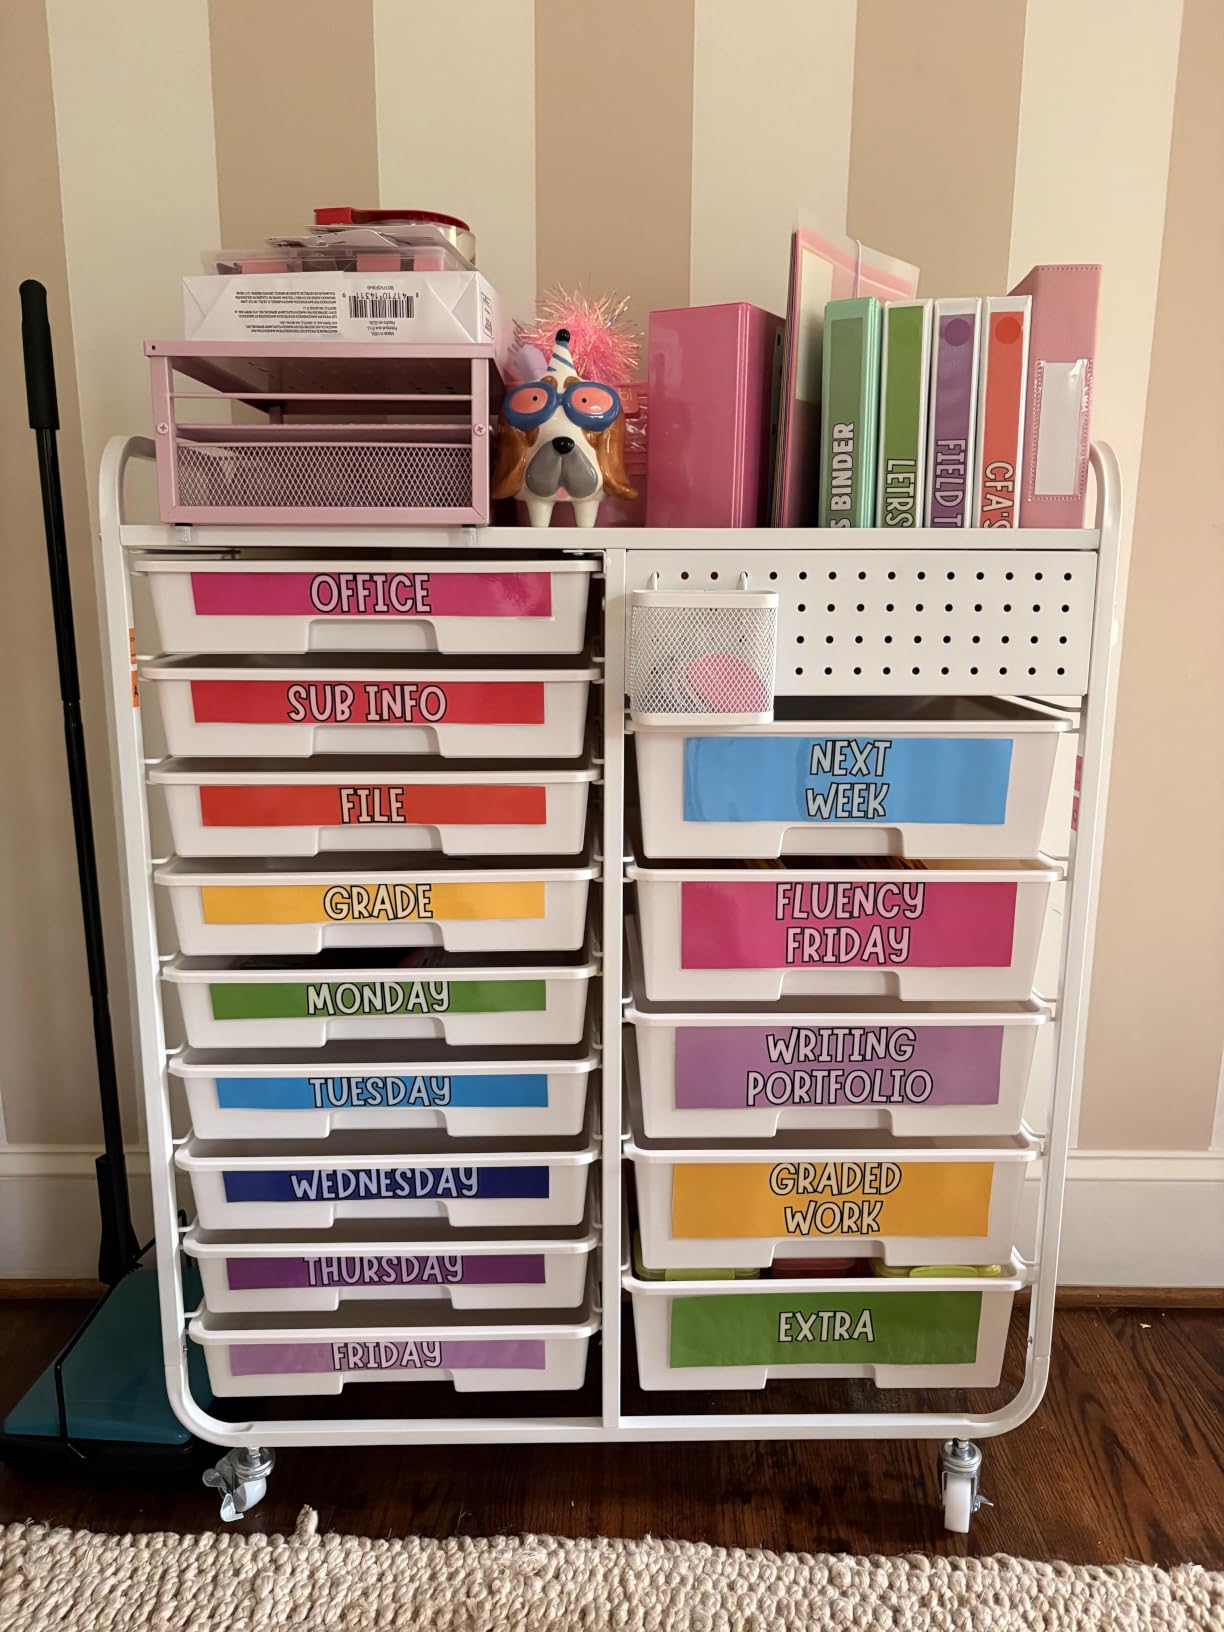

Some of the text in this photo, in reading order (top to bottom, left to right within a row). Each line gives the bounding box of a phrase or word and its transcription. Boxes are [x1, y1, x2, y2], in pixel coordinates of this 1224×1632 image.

[830, 422, 854, 511] BINDER
[934, 438, 966, 508] FIELD
[885, 458, 916, 528] LETRS
[310, 573, 432, 614] OFFICE
[287, 684, 447, 722] SUB INFO
[810, 739, 892, 776] NEXT
[338, 787, 406, 824] FILE
[805, 782, 890, 819] WEEK
[323, 883, 434, 920] GRADE
[775, 882, 925, 920] FLUENCY
[785, 926, 911, 964] FRIDAY
[306, 980, 450, 1015] MONDAY
[766, 1027, 916, 1064] WRITING
[309, 1075, 452, 1108] TUESDAY
[746, 1069, 933, 1107] PORTFOLIO
[290, 1167, 479, 1201] WEDNESDAY
[769, 1162, 902, 1196] GRADED
[783, 1200, 883, 1236] WORK
[302, 1254, 464, 1287] THURSDAY
[778, 1309, 875, 1343] EXTRA
[331, 1340, 443, 1371] FRIDAY
